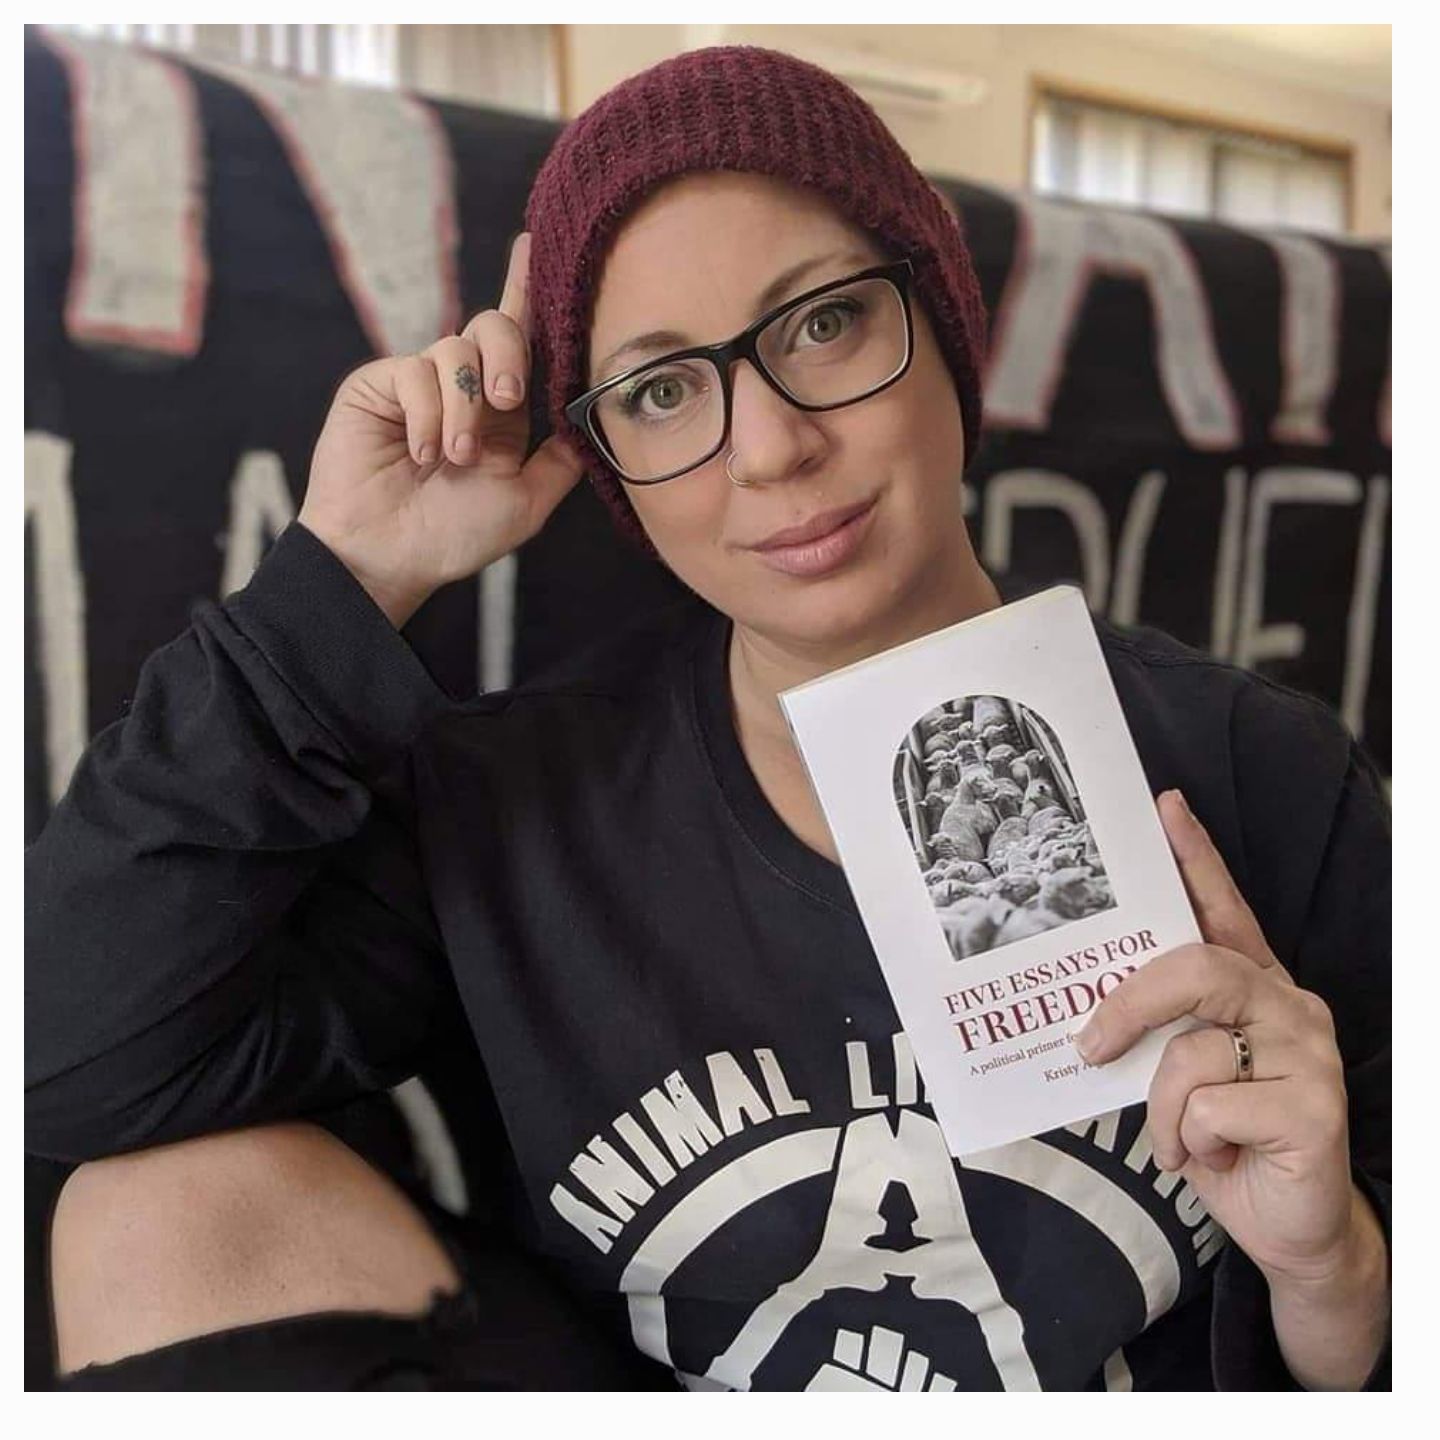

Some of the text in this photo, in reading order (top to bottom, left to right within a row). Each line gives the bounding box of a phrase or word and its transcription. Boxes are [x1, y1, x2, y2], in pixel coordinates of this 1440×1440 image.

[942, 928, 1158, 1017] FIVE ESSAYS FOR
[953, 963, 1140, 1054] FREEDO
[980, 1047, 1026, 1075] political
[1026, 1034, 1065, 1059] primer
[1043, 1061, 1080, 1082] Kristy
[549, 1047, 811, 1255] ANIMAL
